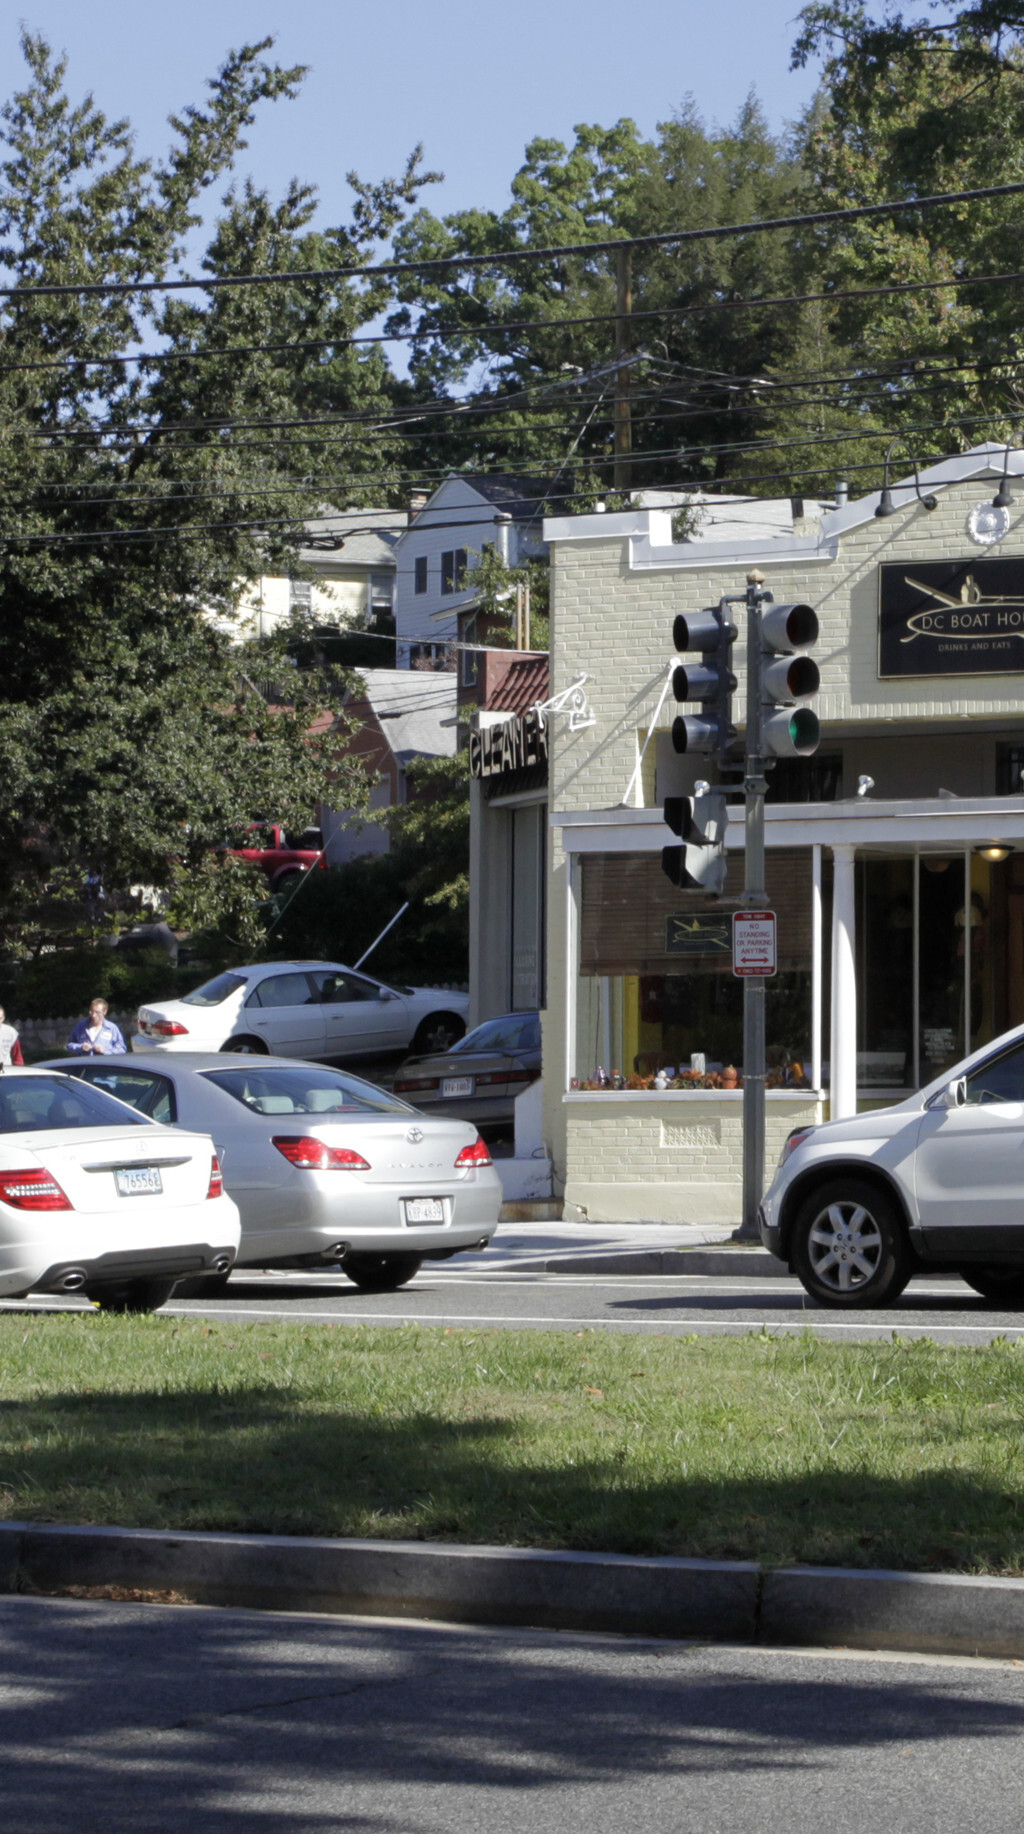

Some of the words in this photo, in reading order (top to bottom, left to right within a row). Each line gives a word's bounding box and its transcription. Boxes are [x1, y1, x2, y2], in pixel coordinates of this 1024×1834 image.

[922, 615, 945, 630] DC
[951, 613, 991, 628] BOAT
[938, 643, 968, 652] DRINKS
[971, 642, 989, 650] AND
[992, 641, 1011, 650] EATS
